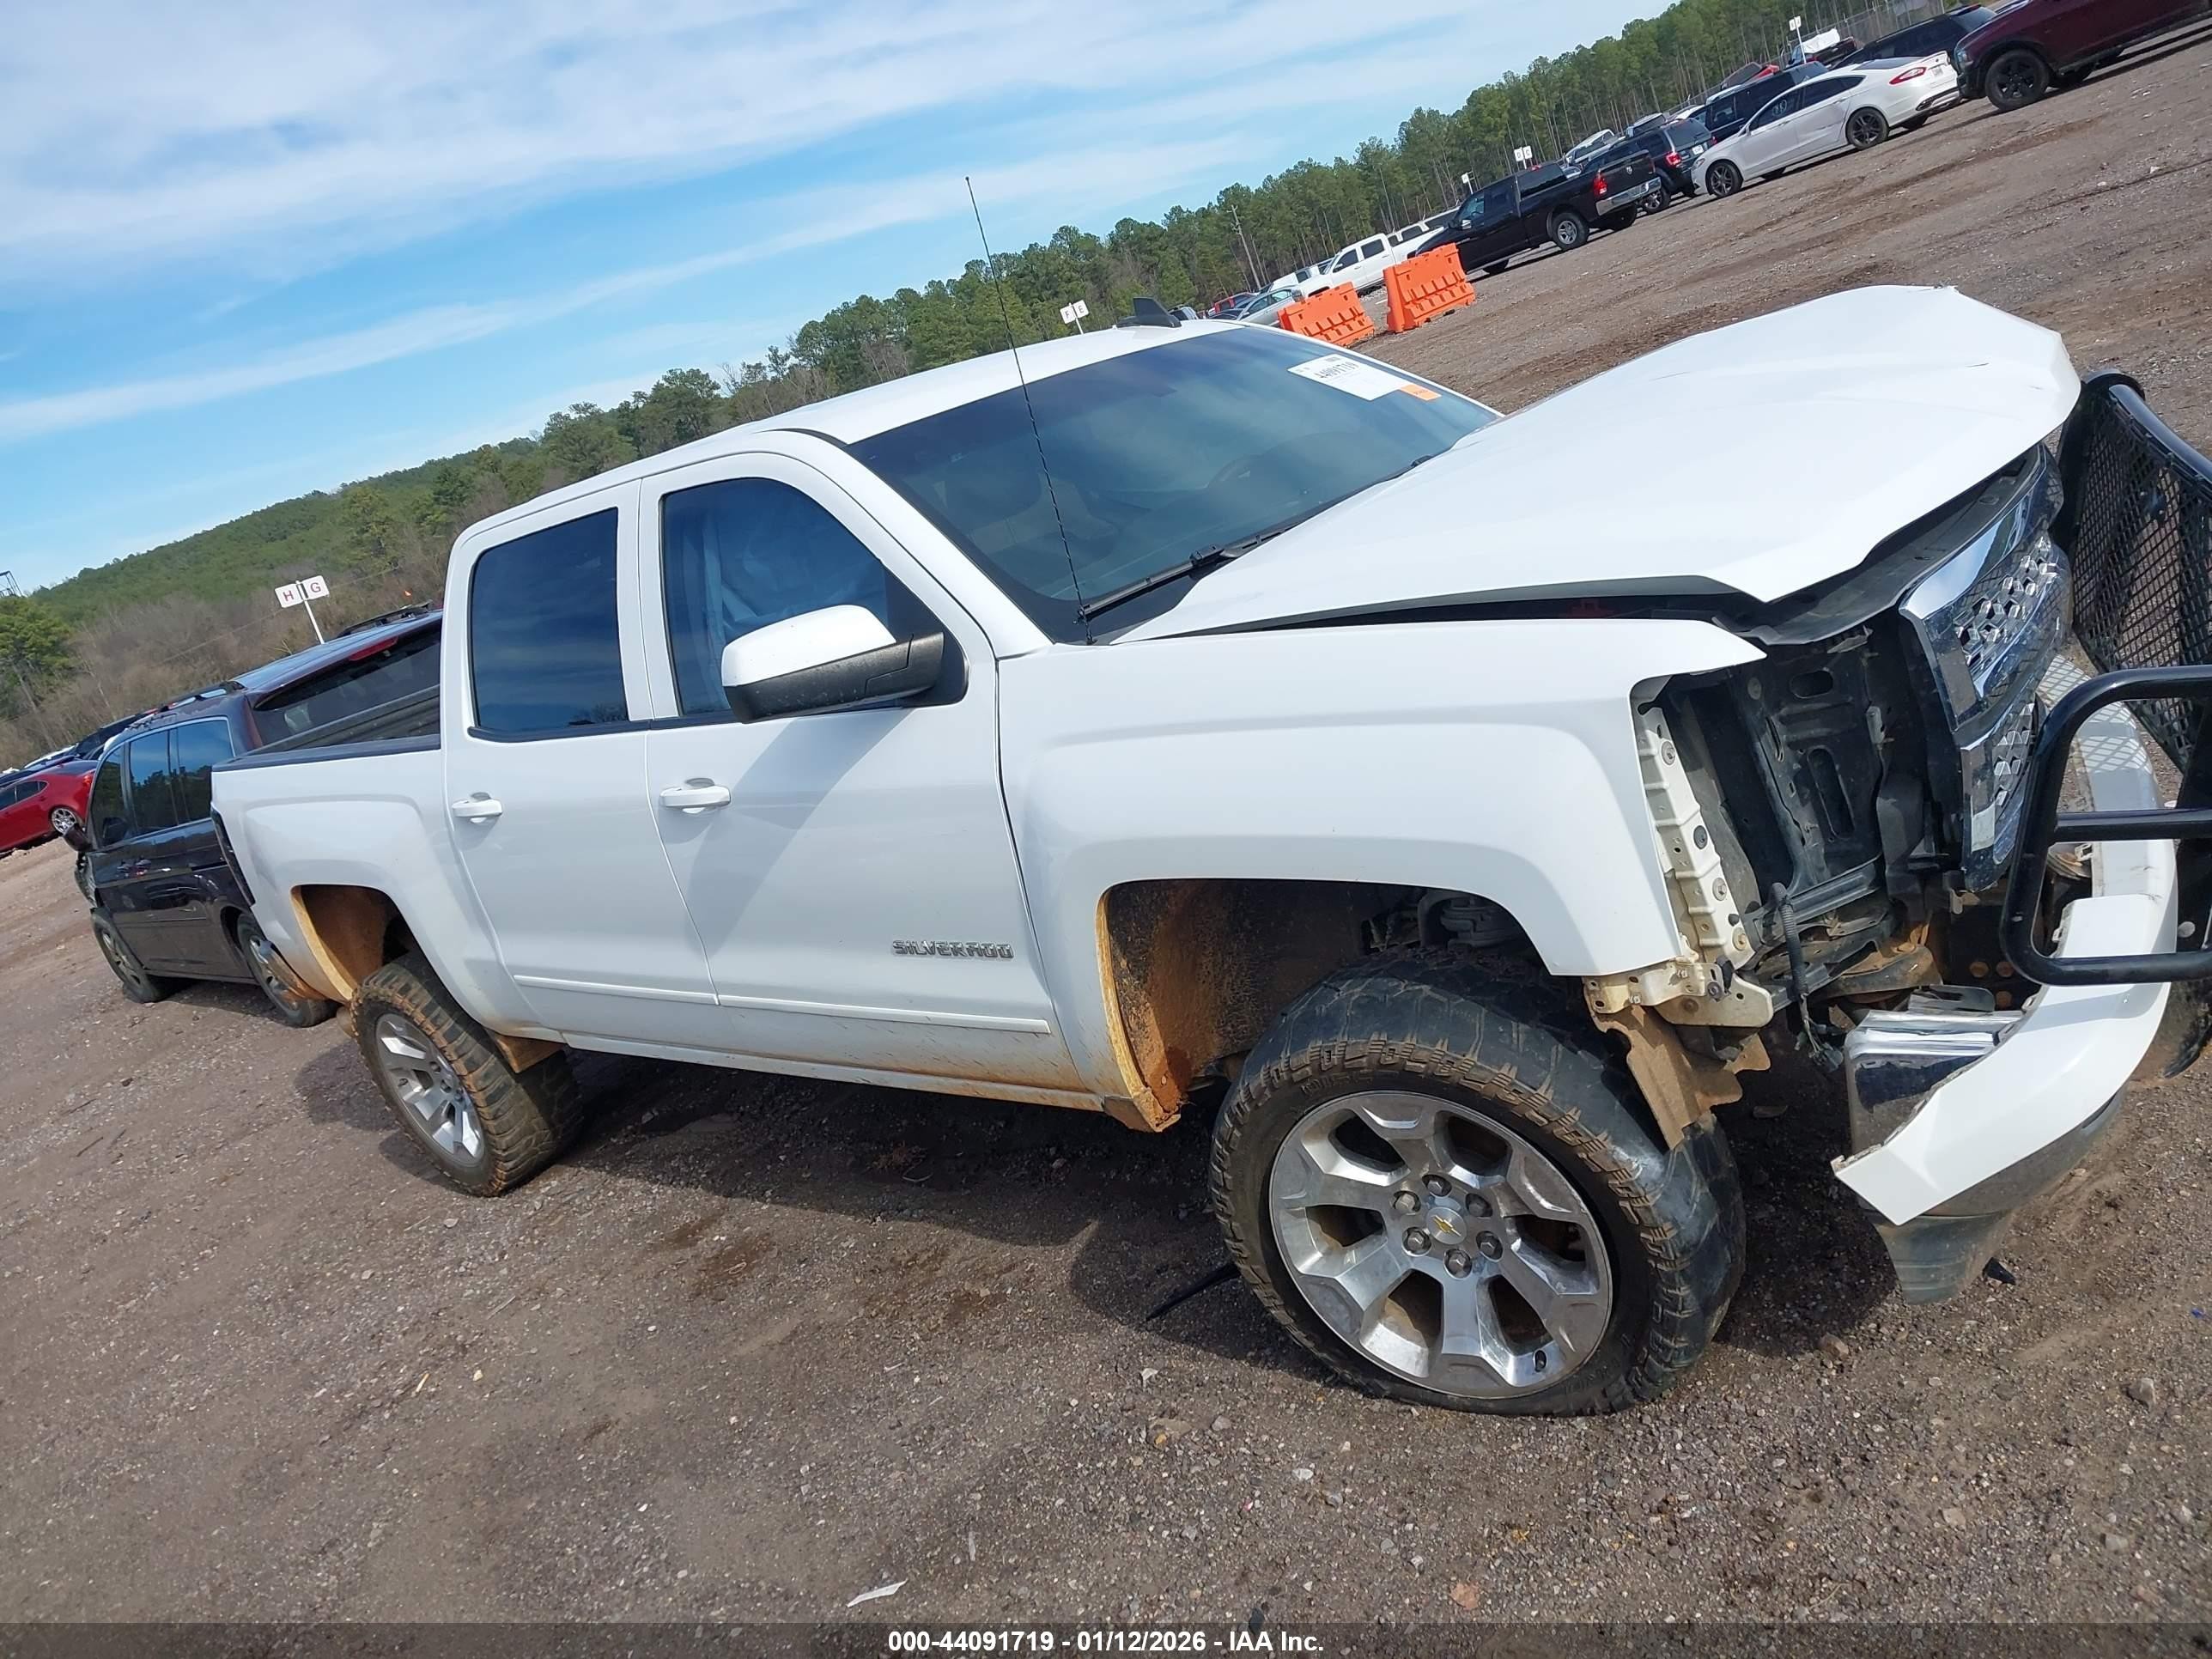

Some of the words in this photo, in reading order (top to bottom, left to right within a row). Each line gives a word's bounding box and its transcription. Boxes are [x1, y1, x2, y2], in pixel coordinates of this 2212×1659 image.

[1078, 305, 1085, 313] E
[283, 590, 295, 602] H
[310, 582, 321, 592] G
[892, 939, 1014, 959] SILVERADO
